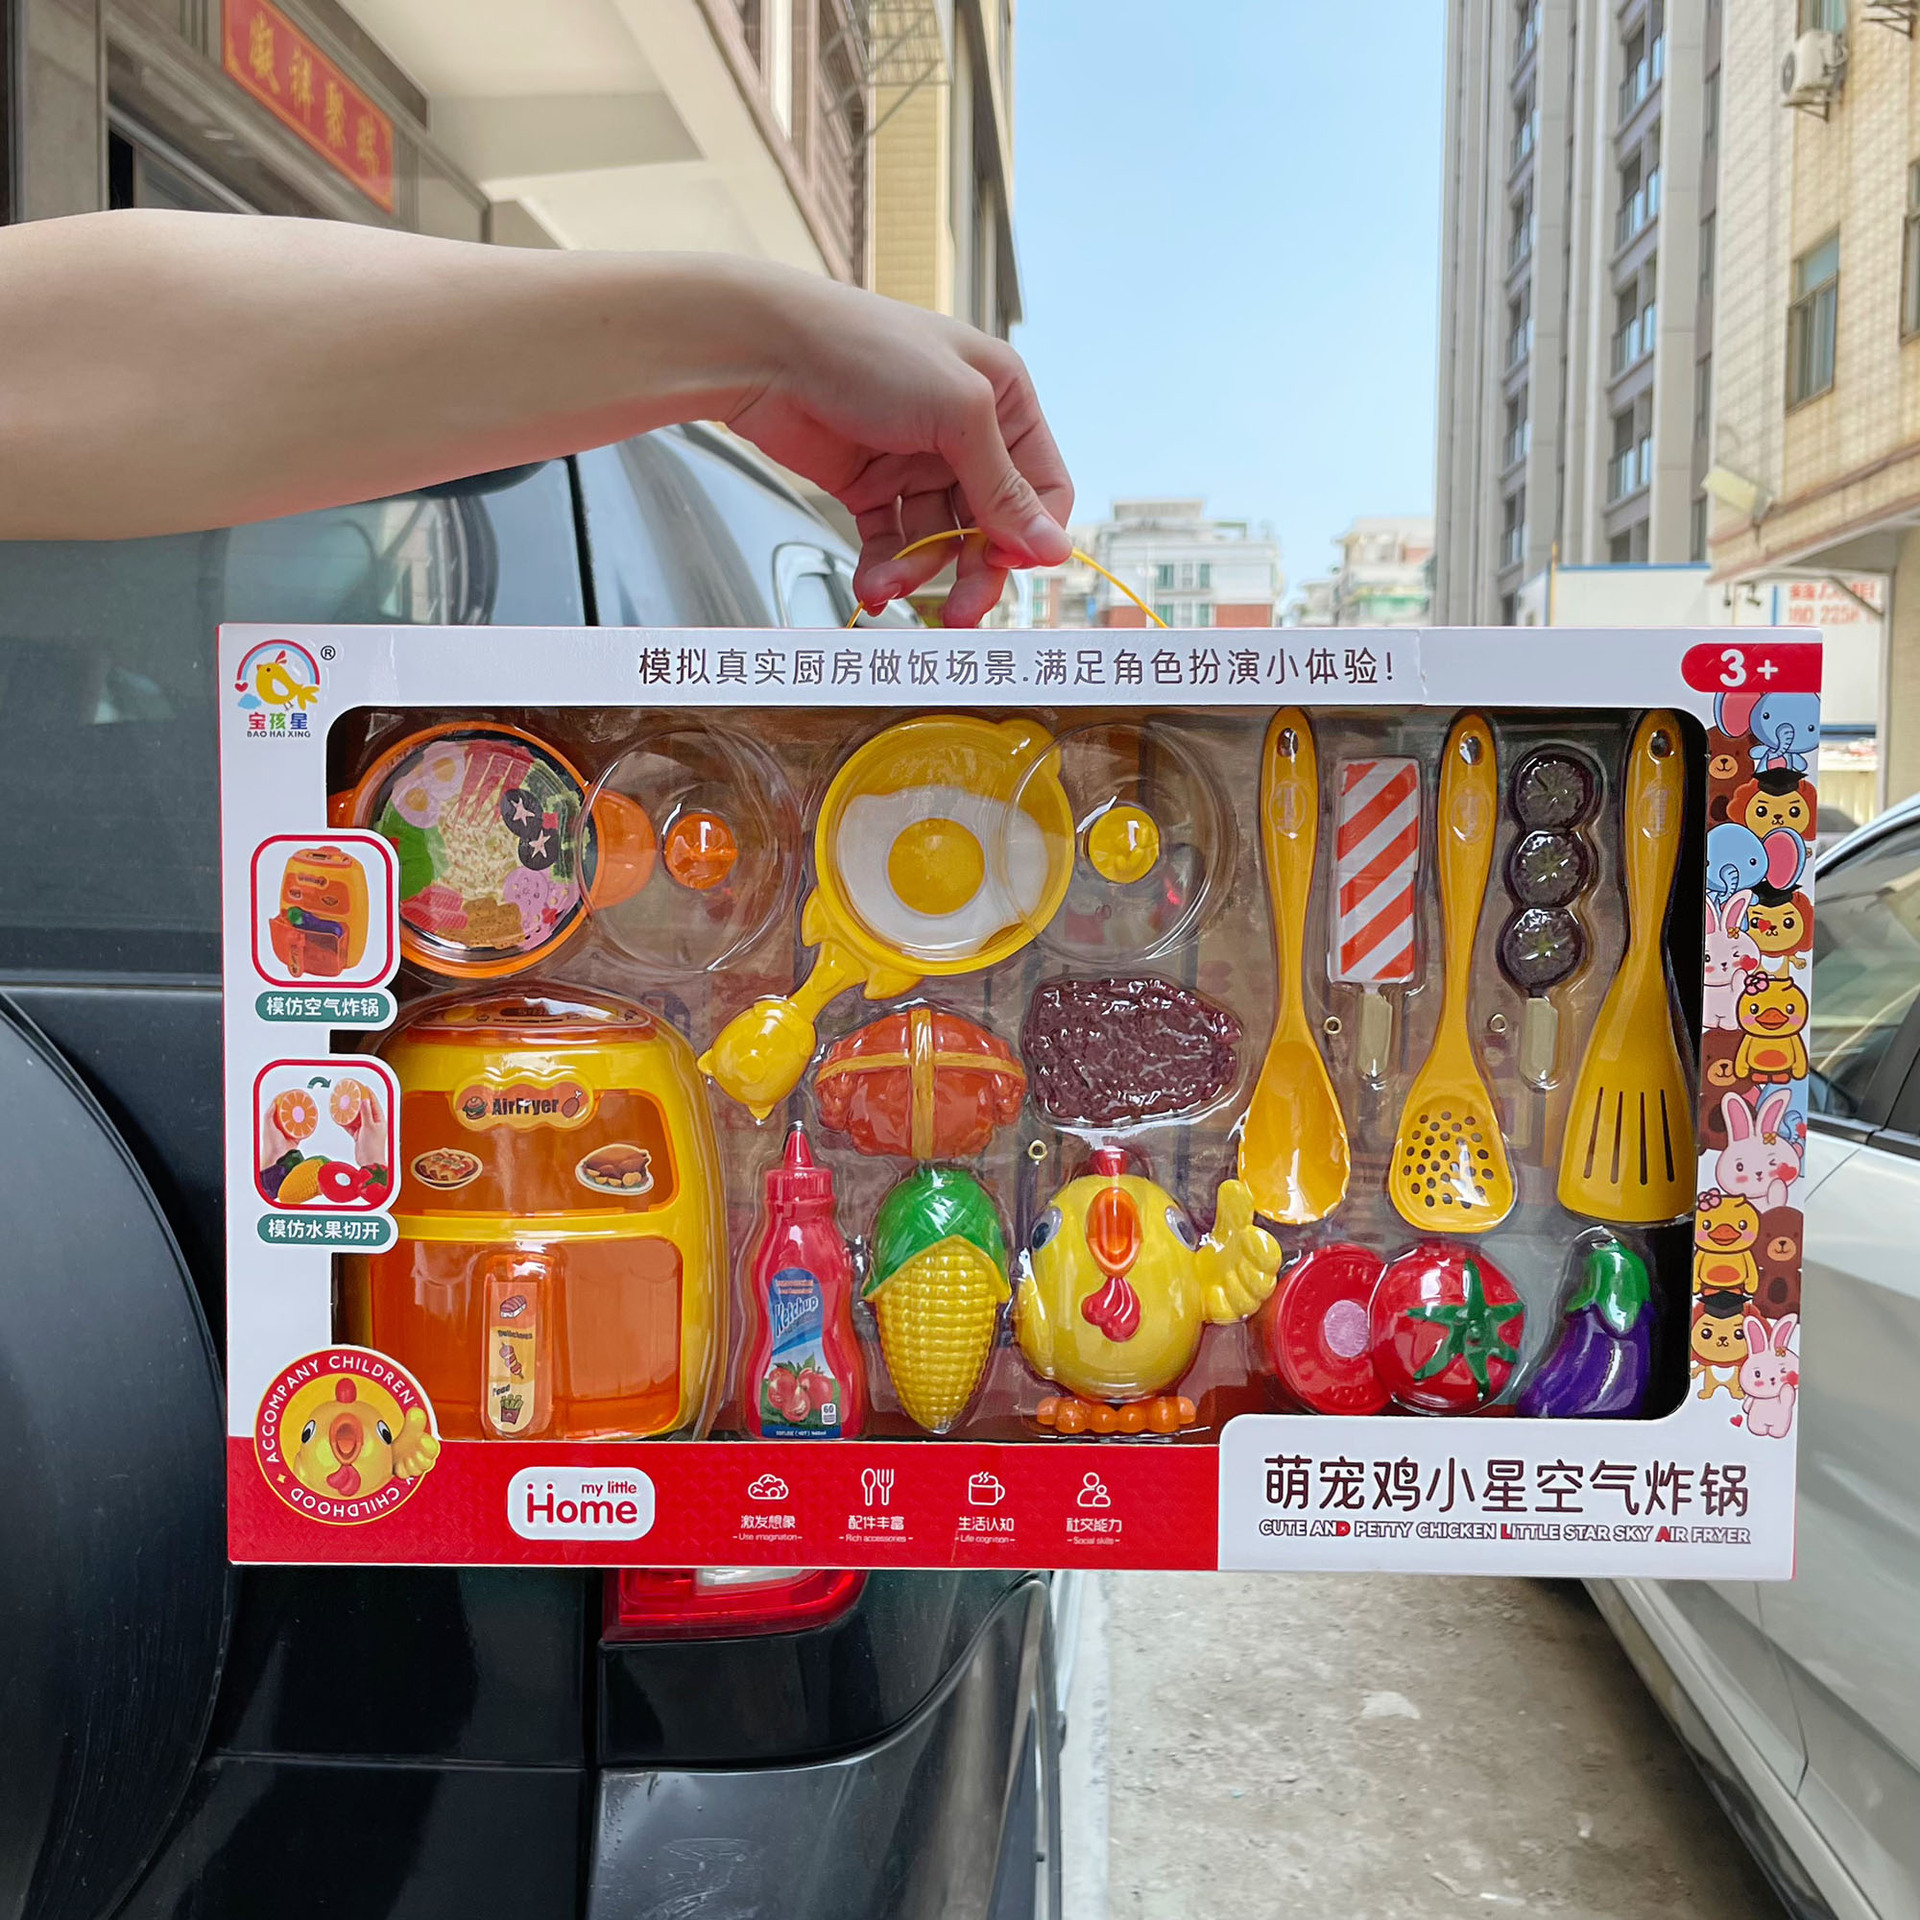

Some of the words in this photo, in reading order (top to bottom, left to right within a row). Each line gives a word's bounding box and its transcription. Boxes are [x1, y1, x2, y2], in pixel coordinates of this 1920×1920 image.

[248, 711, 308, 730] 宝孩星
[266, 996, 379, 1018] 模仿空气炸锅
[268, 1218, 380, 1240] 模仿水果切开
[775, 1296, 819, 1338] Ketchup
[262, 1359, 319, 1463] ACCOMPANY
[328, 1355, 414, 1405] CHILDREN
[581, 1483, 603, 1497] my
[607, 1480, 637, 1494] little
[1264, 1454, 1749, 1517] 萌宠鸡小星空气炸锅
[290, 1487, 400, 1517] CHILDHOOD
[526, 1483, 638, 1524] Home
[741, 1515, 796, 1529] 激发想象
[848, 1515, 905, 1531] 配件丰富
[958, 1516, 1014, 1532] 生活认知
[1066, 1517, 1122, 1533] 社交能力
[1259, 1519, 1307, 1537] CUTE
[1309, 1520, 1351, 1537] AND
[1354, 1521, 1413, 1538] PETTY
[1416, 1522, 1496, 1540] CHICKEN
[1500, 1523, 1560, 1541] LITTLE
[1563, 1525, 1611, 1542] STAR
[1613, 1526, 1653, 1542] SKY
[1655, 1526, 1689, 1544] AIR
[1691, 1527, 1751, 1545] FRYER
